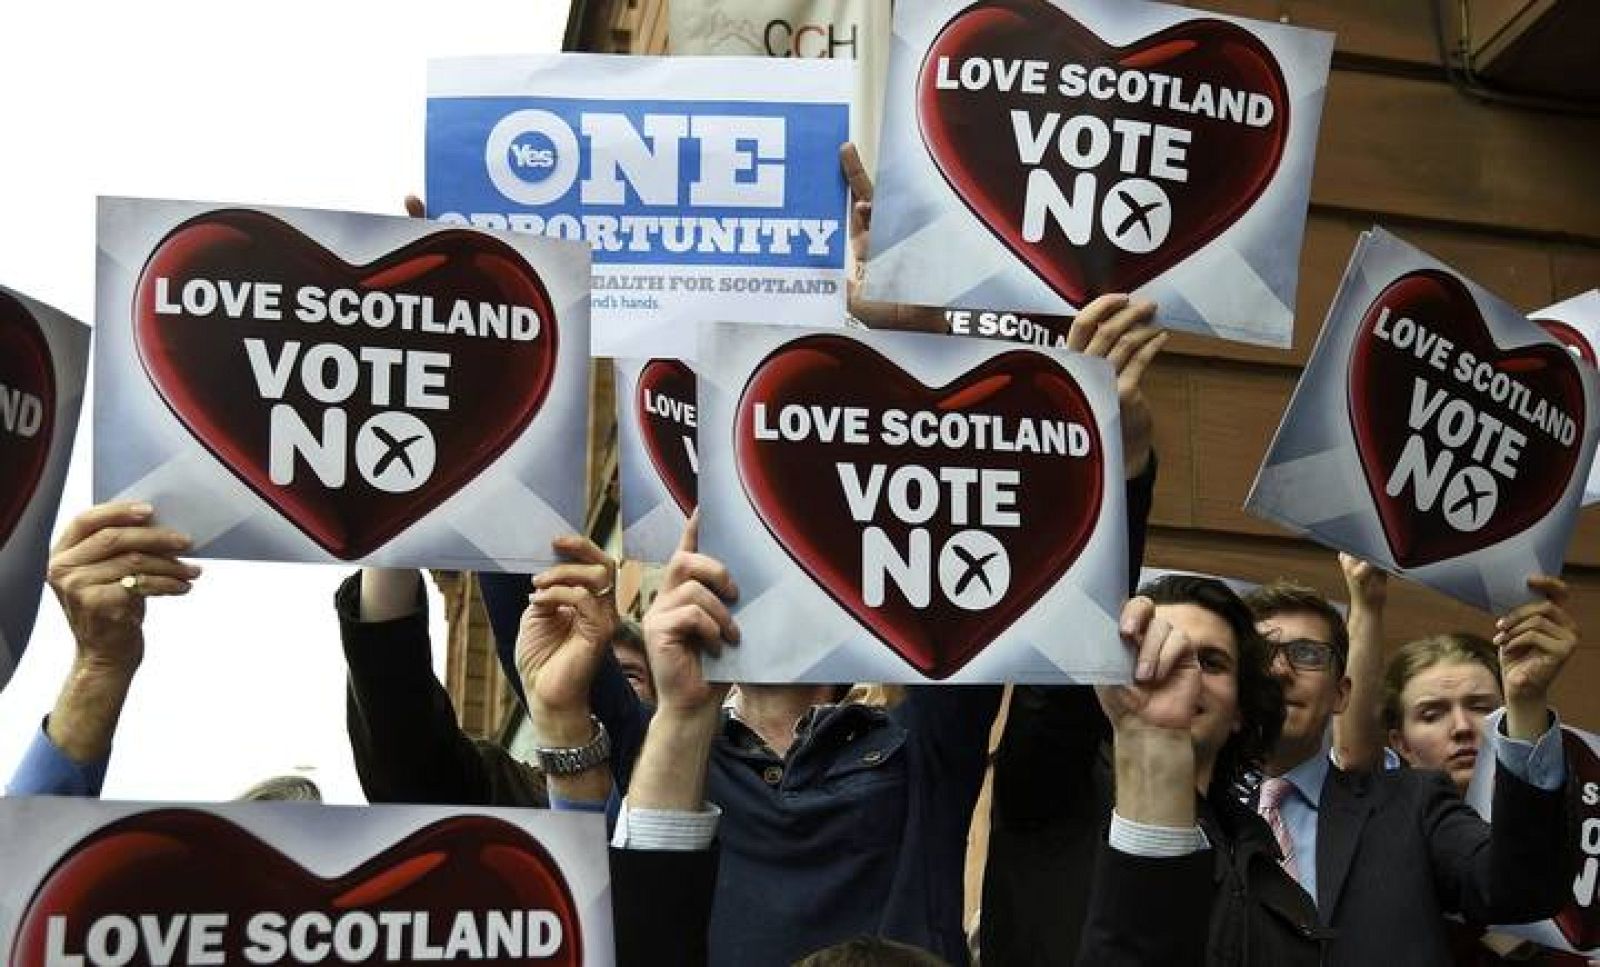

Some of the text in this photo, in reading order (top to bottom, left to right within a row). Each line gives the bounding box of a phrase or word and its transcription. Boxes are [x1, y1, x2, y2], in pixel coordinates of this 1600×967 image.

[764, 18, 857, 59] CCH
[935, 56, 1275, 129] LOVE SCOTLAND
[485, 108, 786, 207] ONE
[511, 143, 554, 168] Yes
[1010, 109, 1192, 183] VOTE
[1021, 168, 1173, 254] NO
[153, 276, 542, 342] LOVE SCOTLAND
[669, 277, 714, 292] FOR
[719, 277, 838, 294] SCOTLAND
[243, 337, 452, 410] VOTE
[643, 388, 698, 428] LOVE
[1373, 306, 1577, 447] LOVE SCOTLAND
[268, 404, 437, 493] NO
[752, 402, 1091, 458] LOVE SCOTLAND
[1408, 377, 1529, 480] VOTE
[835, 462, 1021, 527] VOTE
[1385, 434, 1500, 533] NO
[861, 526, 1012, 610] NO
[46, 911, 564, 967] LOVE SCOTLAND
